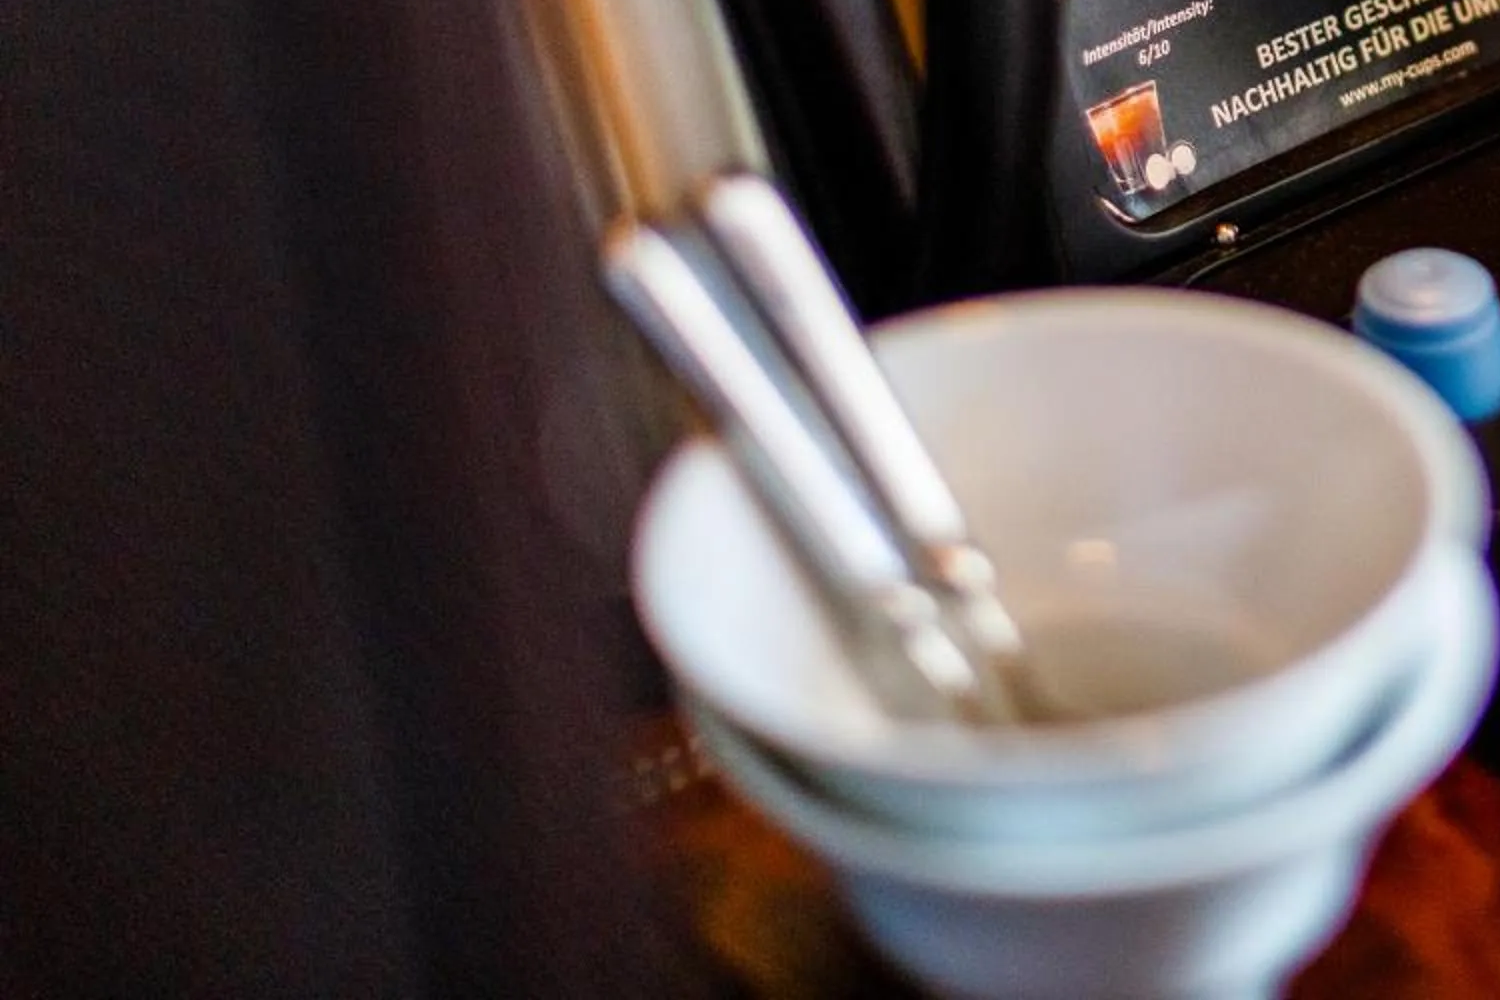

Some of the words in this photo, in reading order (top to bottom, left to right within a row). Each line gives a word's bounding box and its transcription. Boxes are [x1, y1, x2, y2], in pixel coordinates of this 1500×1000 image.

[1138, 39, 1171, 66] 6/10
[1211, 45, 1357, 128] NACHHALTIG
[1359, 22, 1410, 64] FÜR
[1410, 5, 1454, 43] DIE
[1256, 14, 1342, 69] BESTER
[1338, 40, 1479, 108] www.my-cups.com
